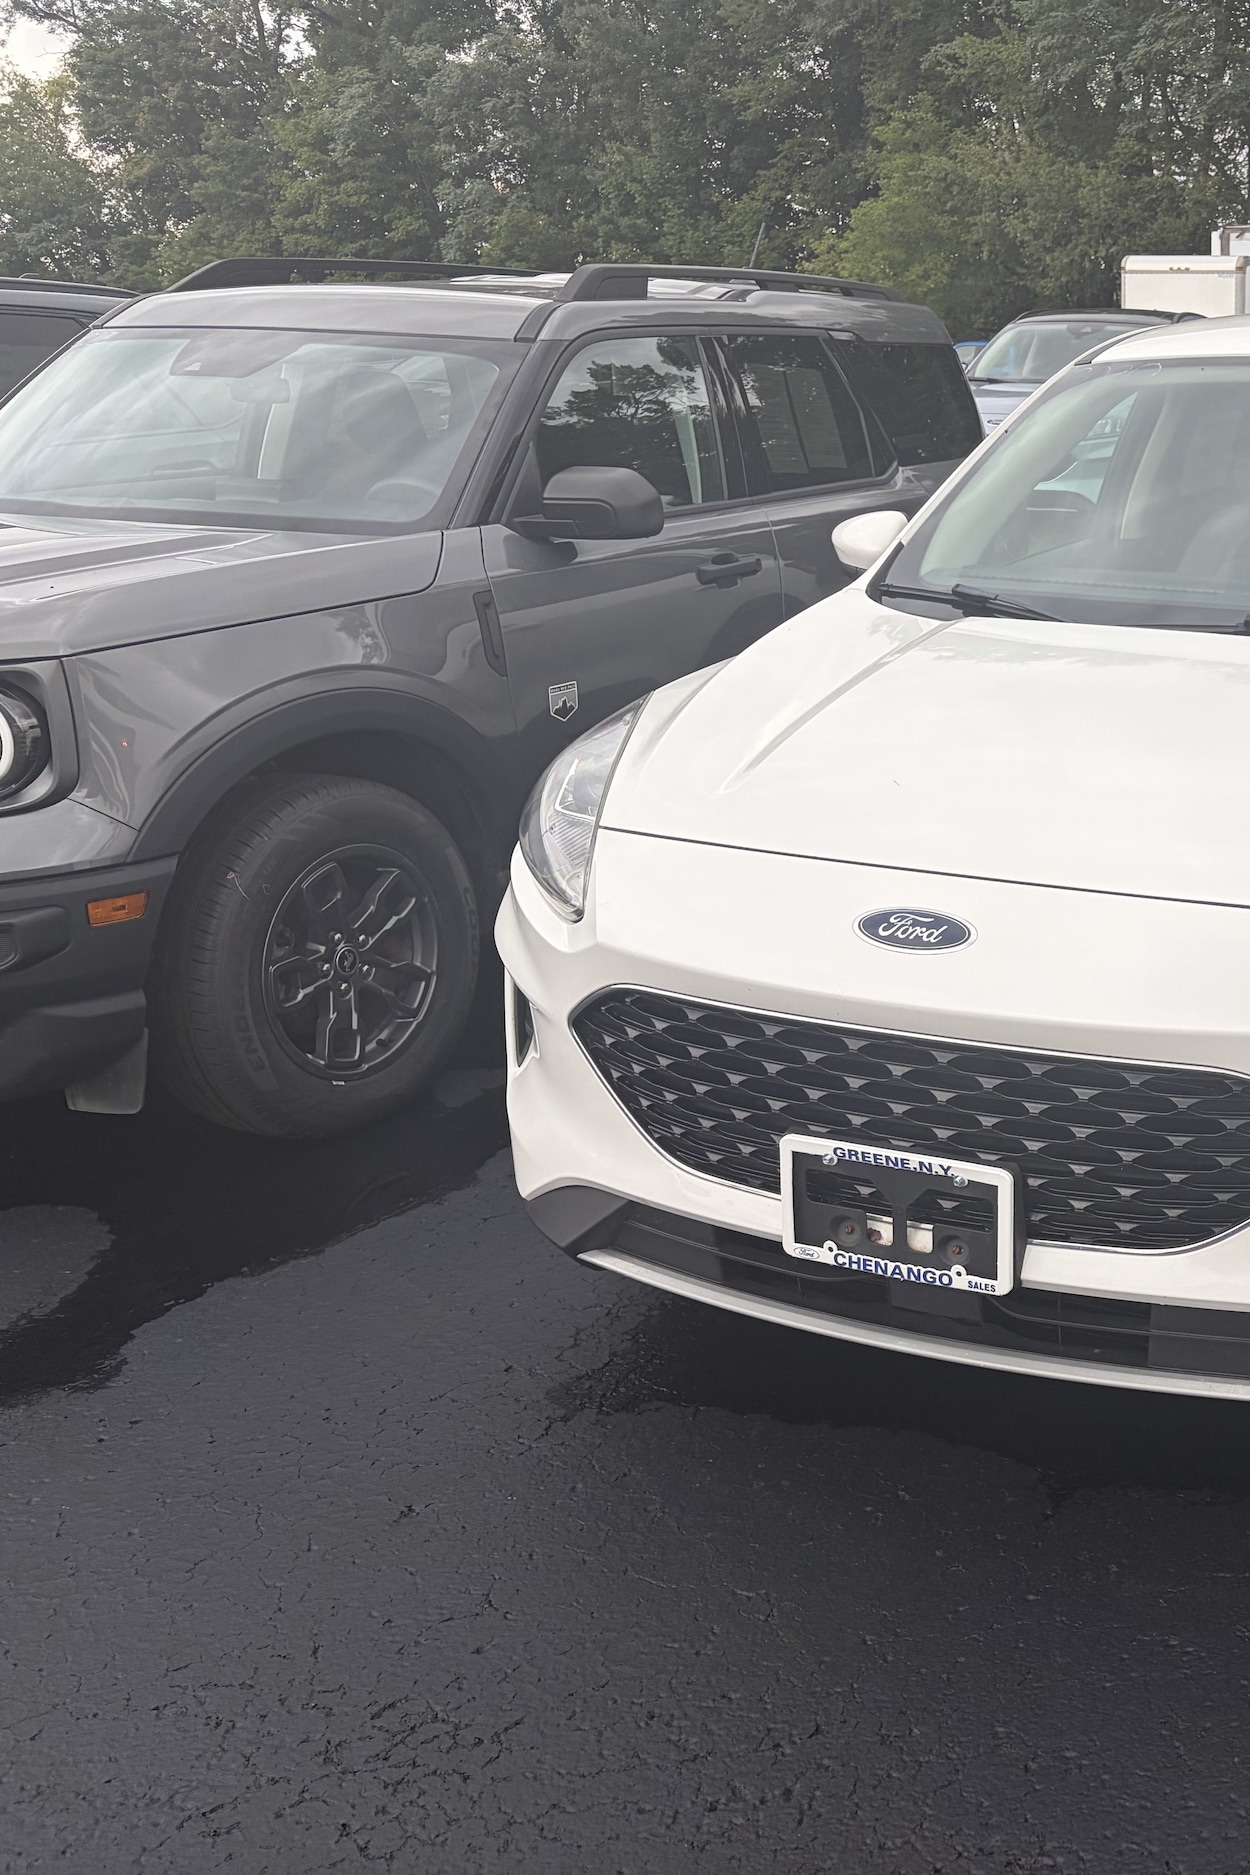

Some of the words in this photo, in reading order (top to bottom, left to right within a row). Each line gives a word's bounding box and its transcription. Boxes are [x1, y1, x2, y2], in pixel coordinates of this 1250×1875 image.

[877, 912, 949, 943] Ford
[834, 1252, 953, 1287] CHENANGO
[967, 1280, 996, 1293] SALES
